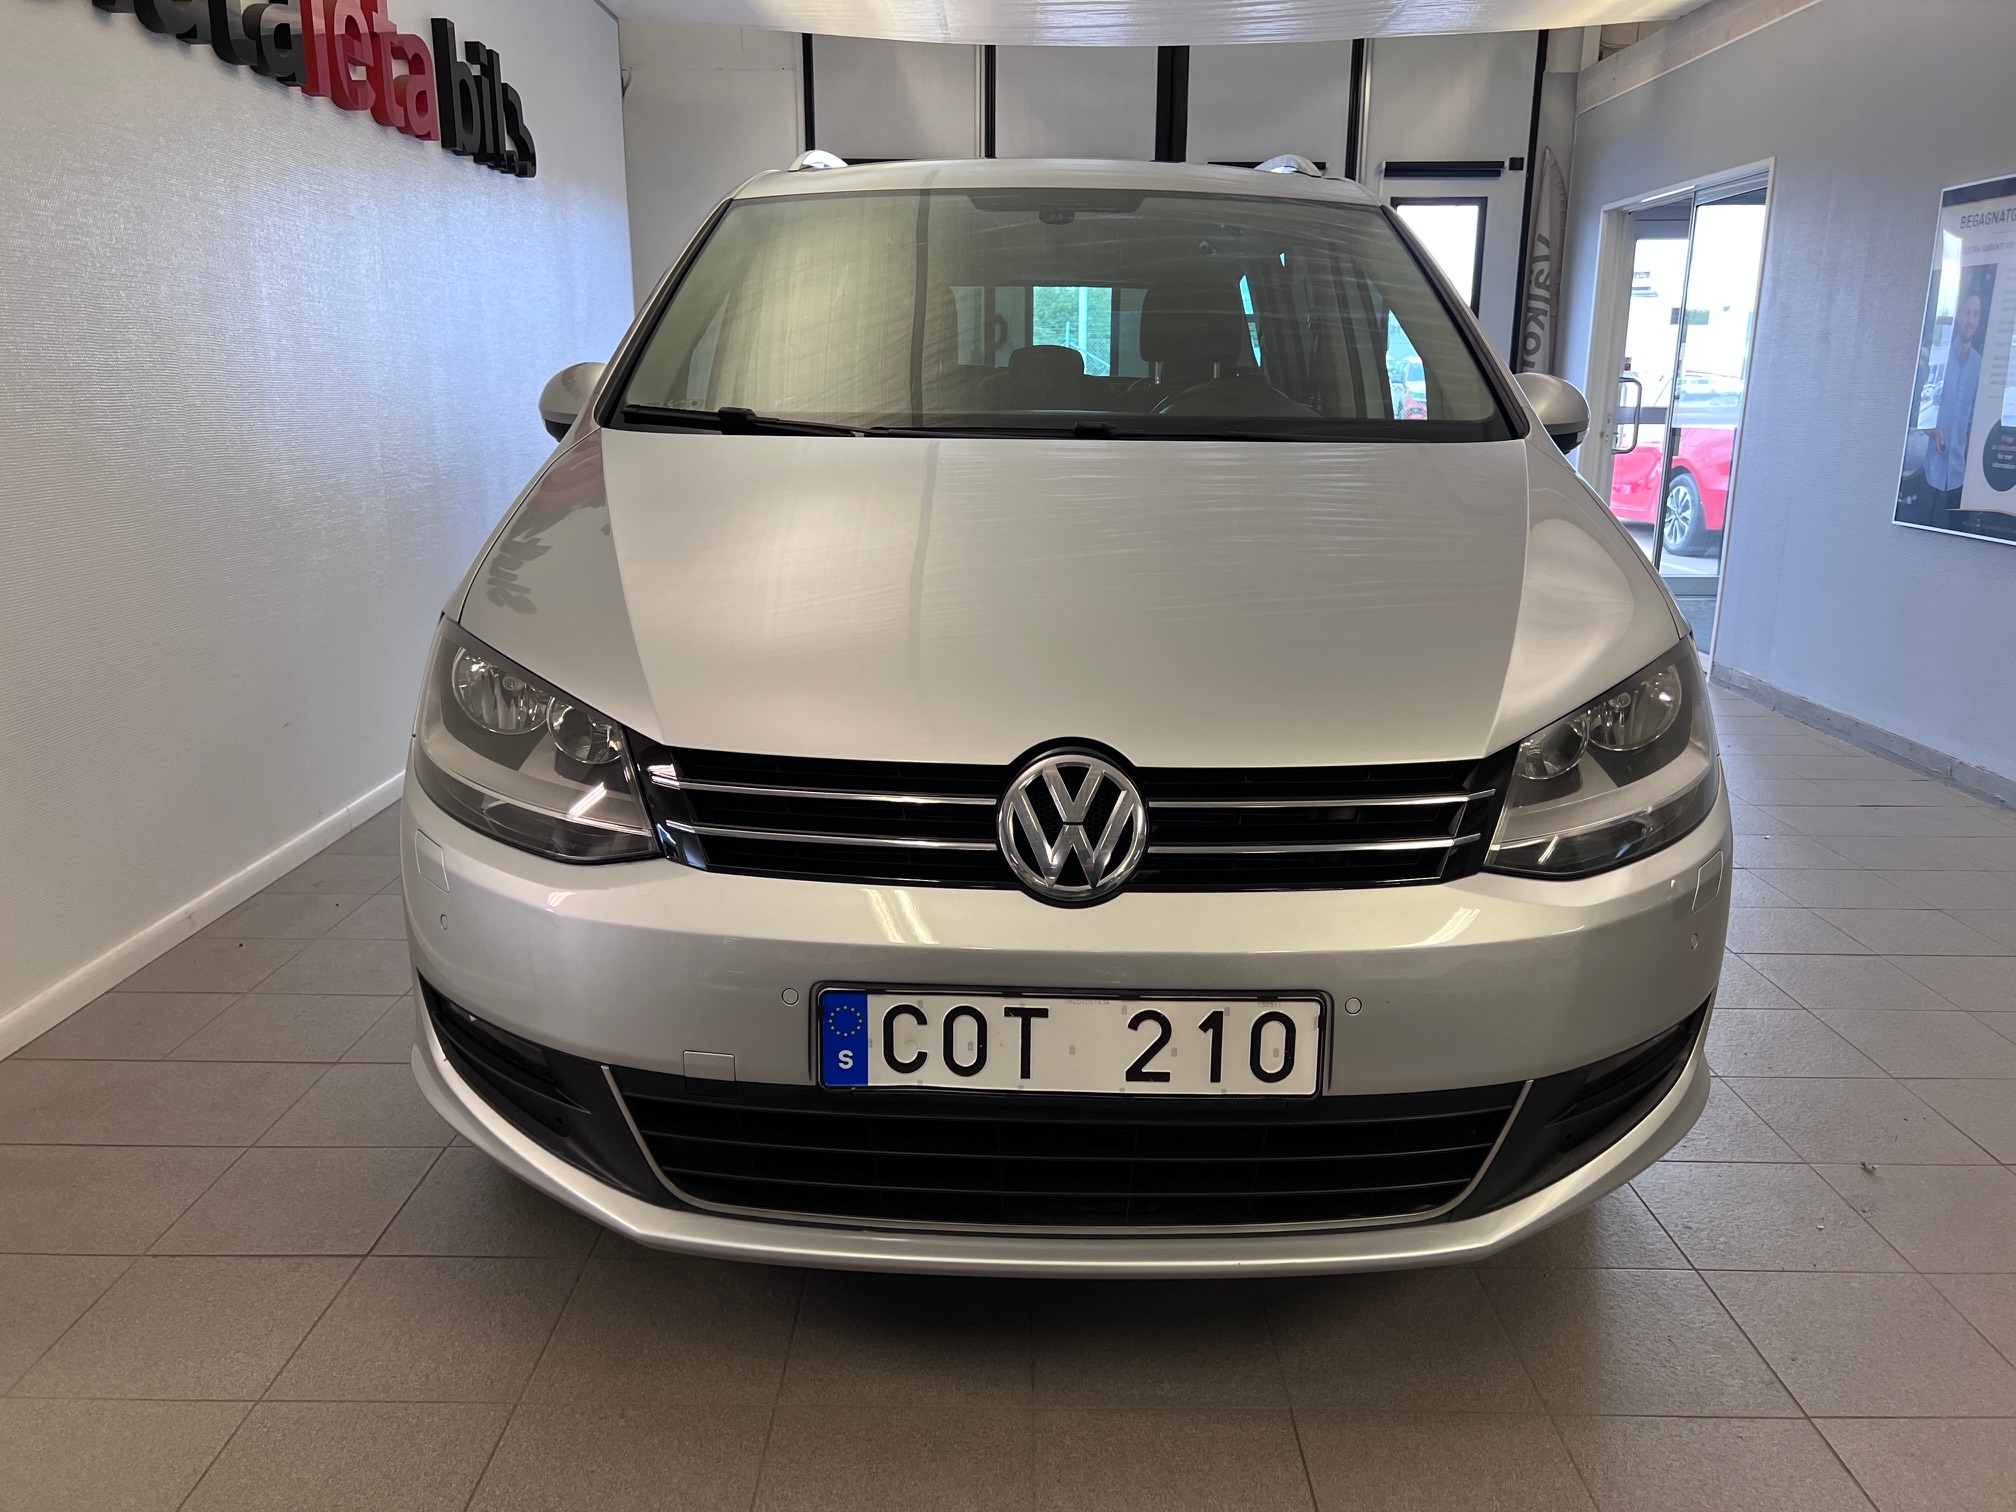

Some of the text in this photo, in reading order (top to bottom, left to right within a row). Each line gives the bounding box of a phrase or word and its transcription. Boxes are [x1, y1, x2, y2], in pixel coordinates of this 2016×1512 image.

[838, 1049, 854, 1070] S
[882, 1003, 1297, 1083] COT 210
